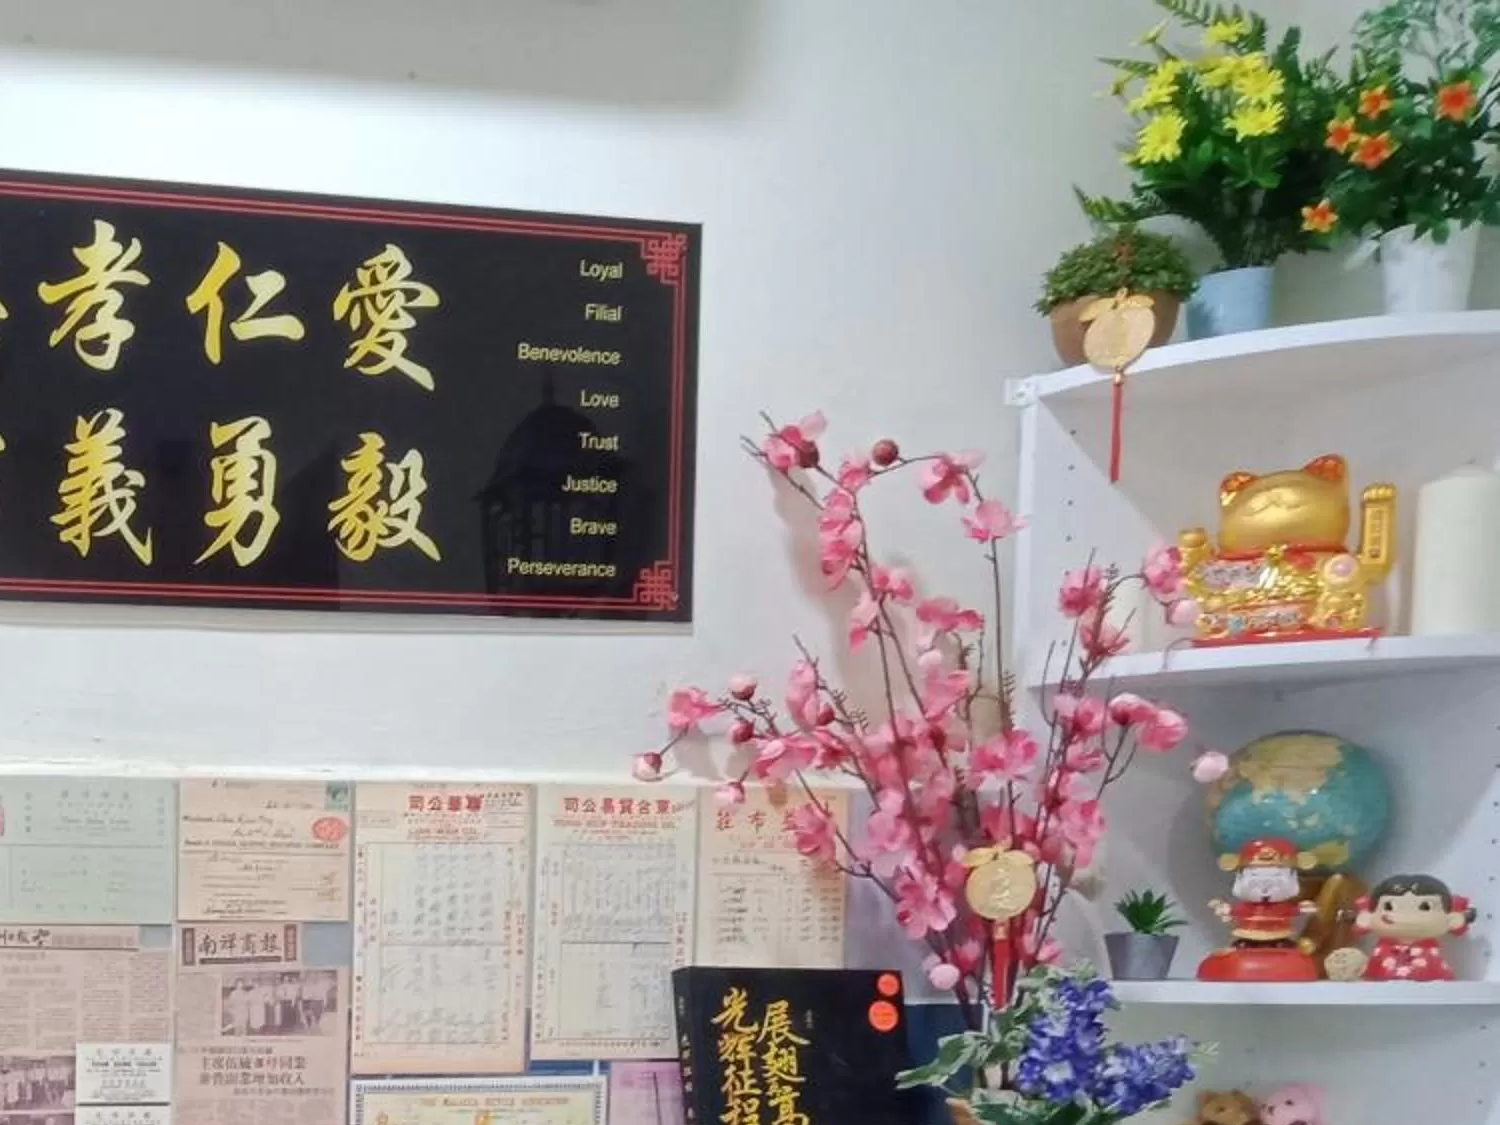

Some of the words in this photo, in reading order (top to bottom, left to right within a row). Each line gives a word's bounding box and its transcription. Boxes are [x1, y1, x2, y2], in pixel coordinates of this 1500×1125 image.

[579, 259, 624, 282] Loyal
[585, 303, 623, 323] Filial
[517, 342, 622, 366] Benevolence
[580, 389, 620, 409] Love
[579, 431, 620, 452] Trust
[562, 474, 619, 495] Justice
[570, 517, 618, 536] Brave
[507, 557, 617, 579] Perseverance
